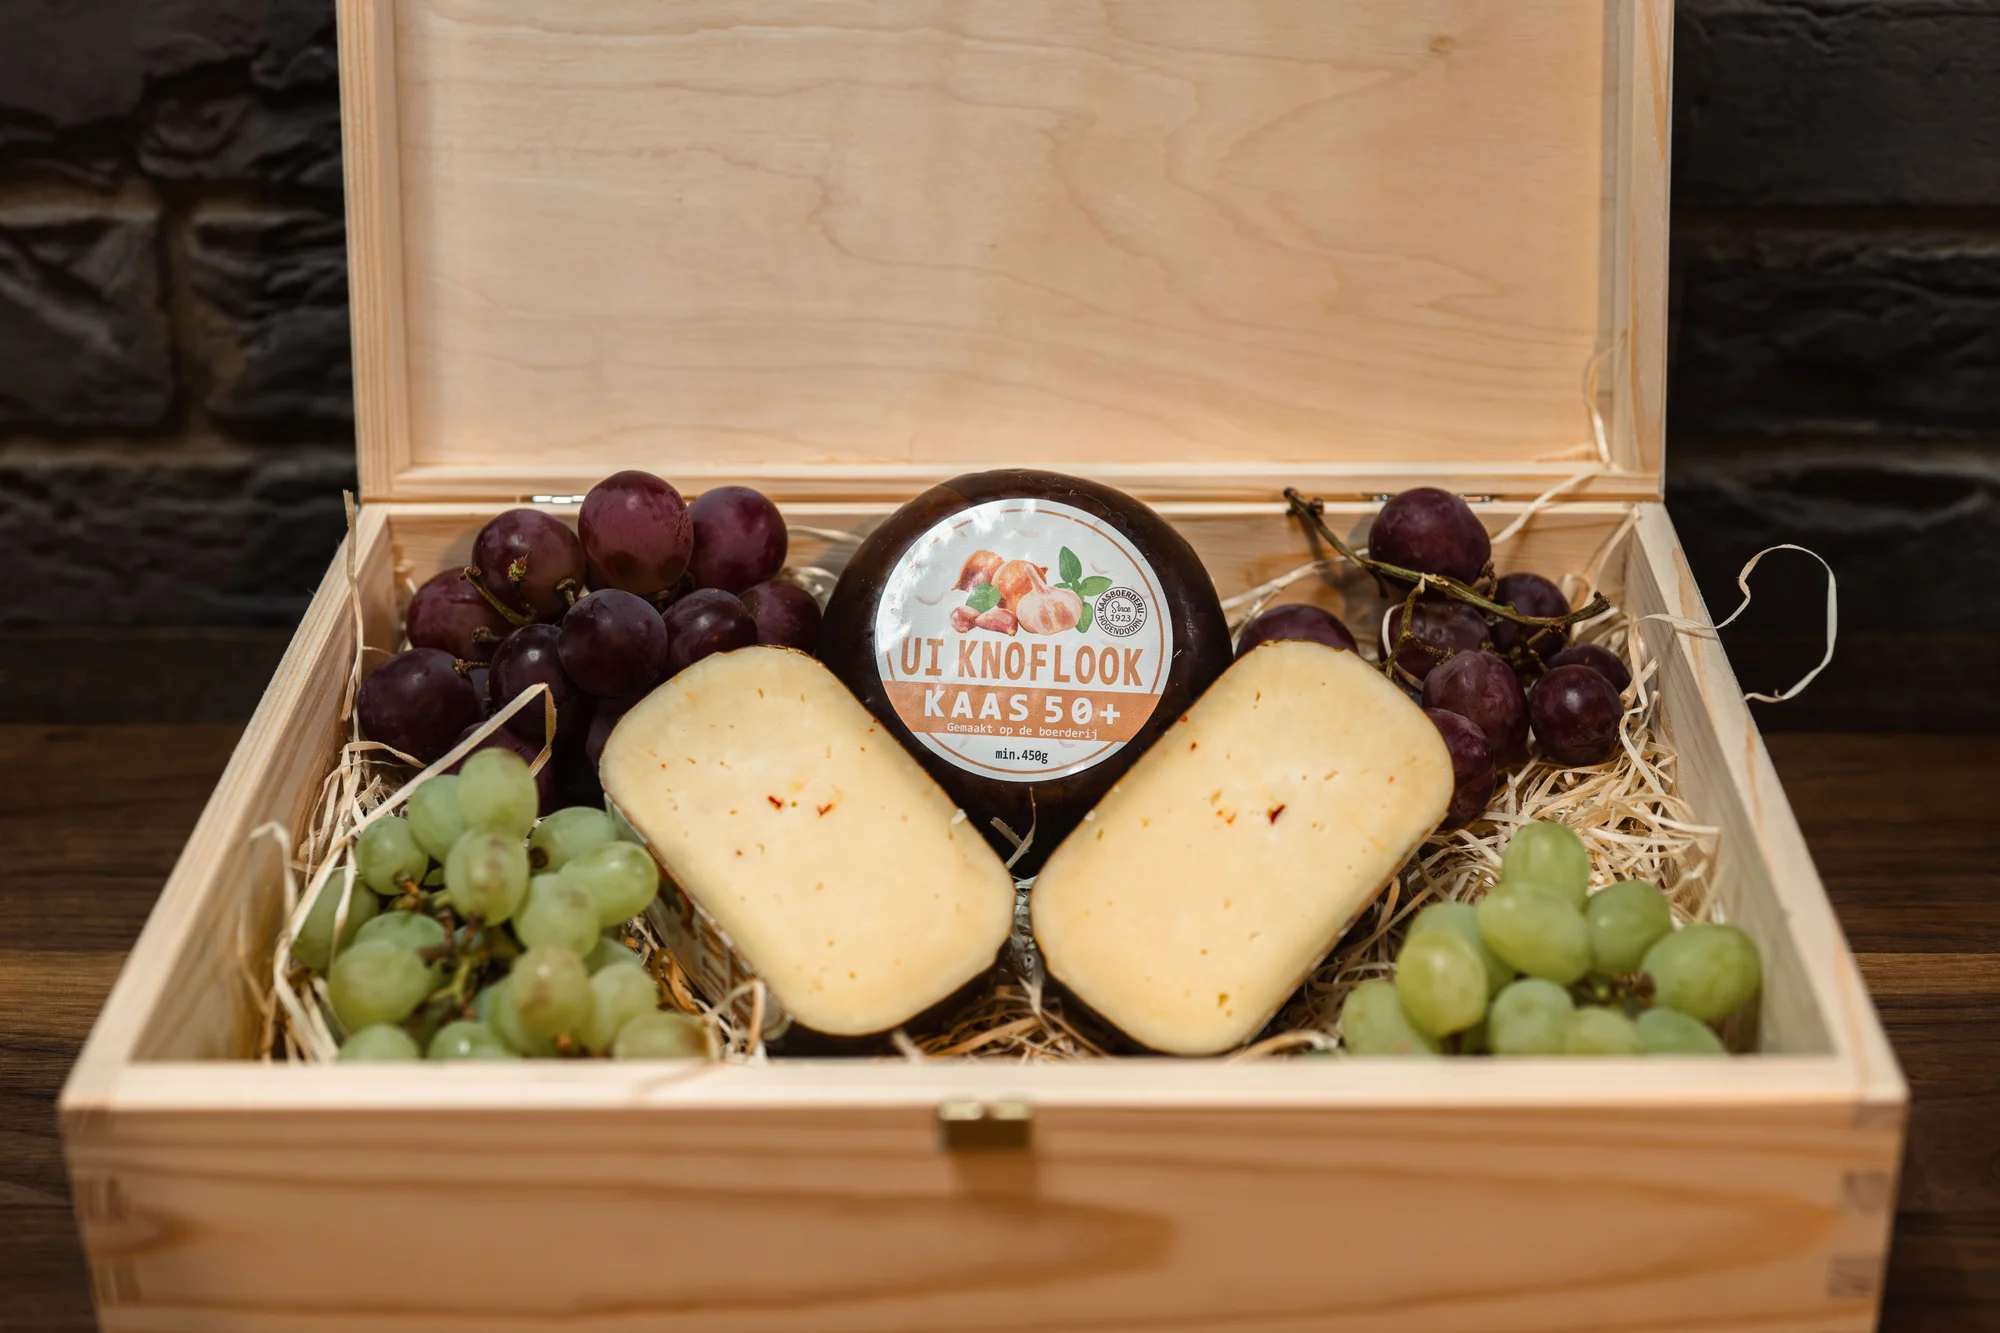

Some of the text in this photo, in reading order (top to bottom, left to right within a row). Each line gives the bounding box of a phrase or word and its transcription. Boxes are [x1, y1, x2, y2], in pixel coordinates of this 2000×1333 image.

[1111, 601, 1131, 613] Since
[1098, 615, 1142, 635] HOGENDOORN
[901, 637, 1144, 687] UI KNOFLOOK
[924, 690, 1120, 725] KAAS 50+
[947, 722, 1098, 740] Gemaakt op de boerderij
[995, 749, 1048, 764] min.450g
